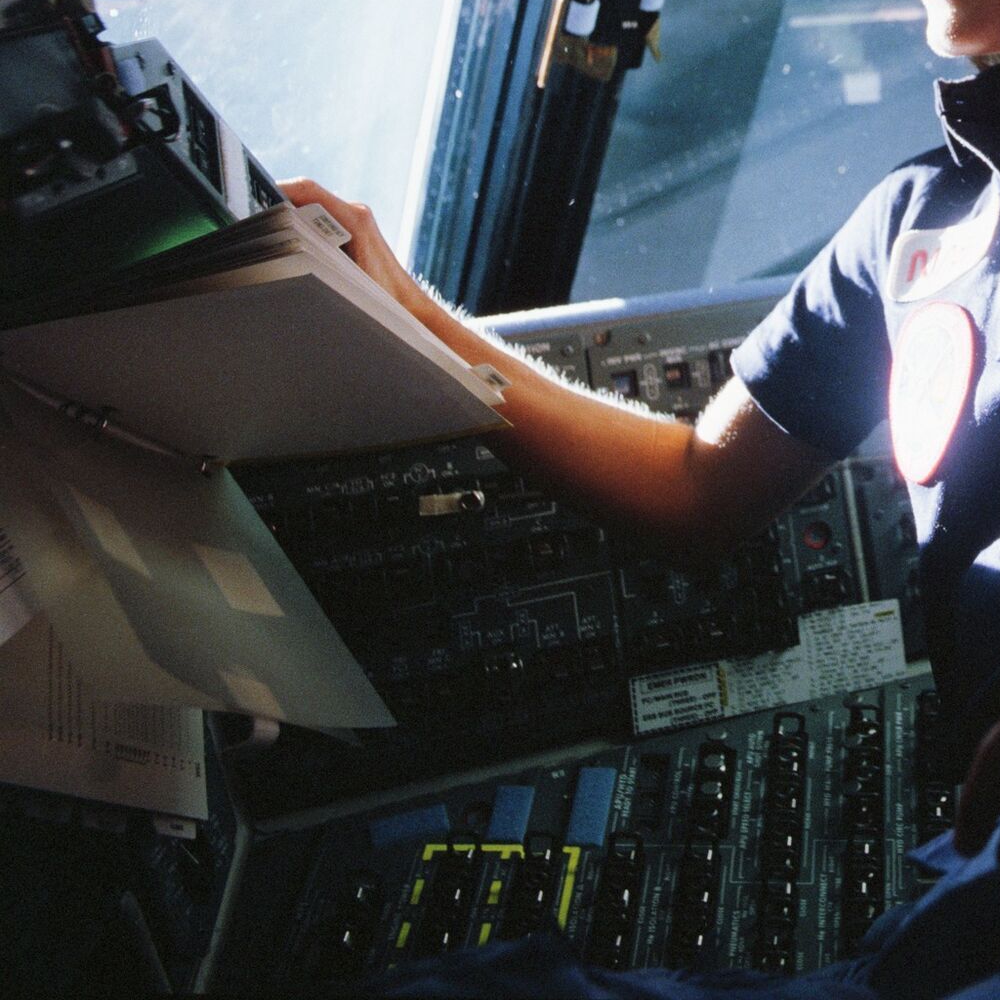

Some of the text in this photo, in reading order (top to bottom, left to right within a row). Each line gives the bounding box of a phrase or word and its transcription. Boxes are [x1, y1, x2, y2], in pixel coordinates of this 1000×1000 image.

[895, 711, 903, 725] PWR
[747, 733, 755, 750] AUTO
[895, 743, 904, 757] APU
[622, 796, 632, 817] READY
[627, 767, 636, 784] START
[895, 803, 904, 821] PUMP
[740, 816, 750, 833] SPEED
[814, 873, 831, 928] INTERCONNECT
[649, 893, 660, 933] ISOLATION
[728, 910, 741, 957] PNEUMATICS
